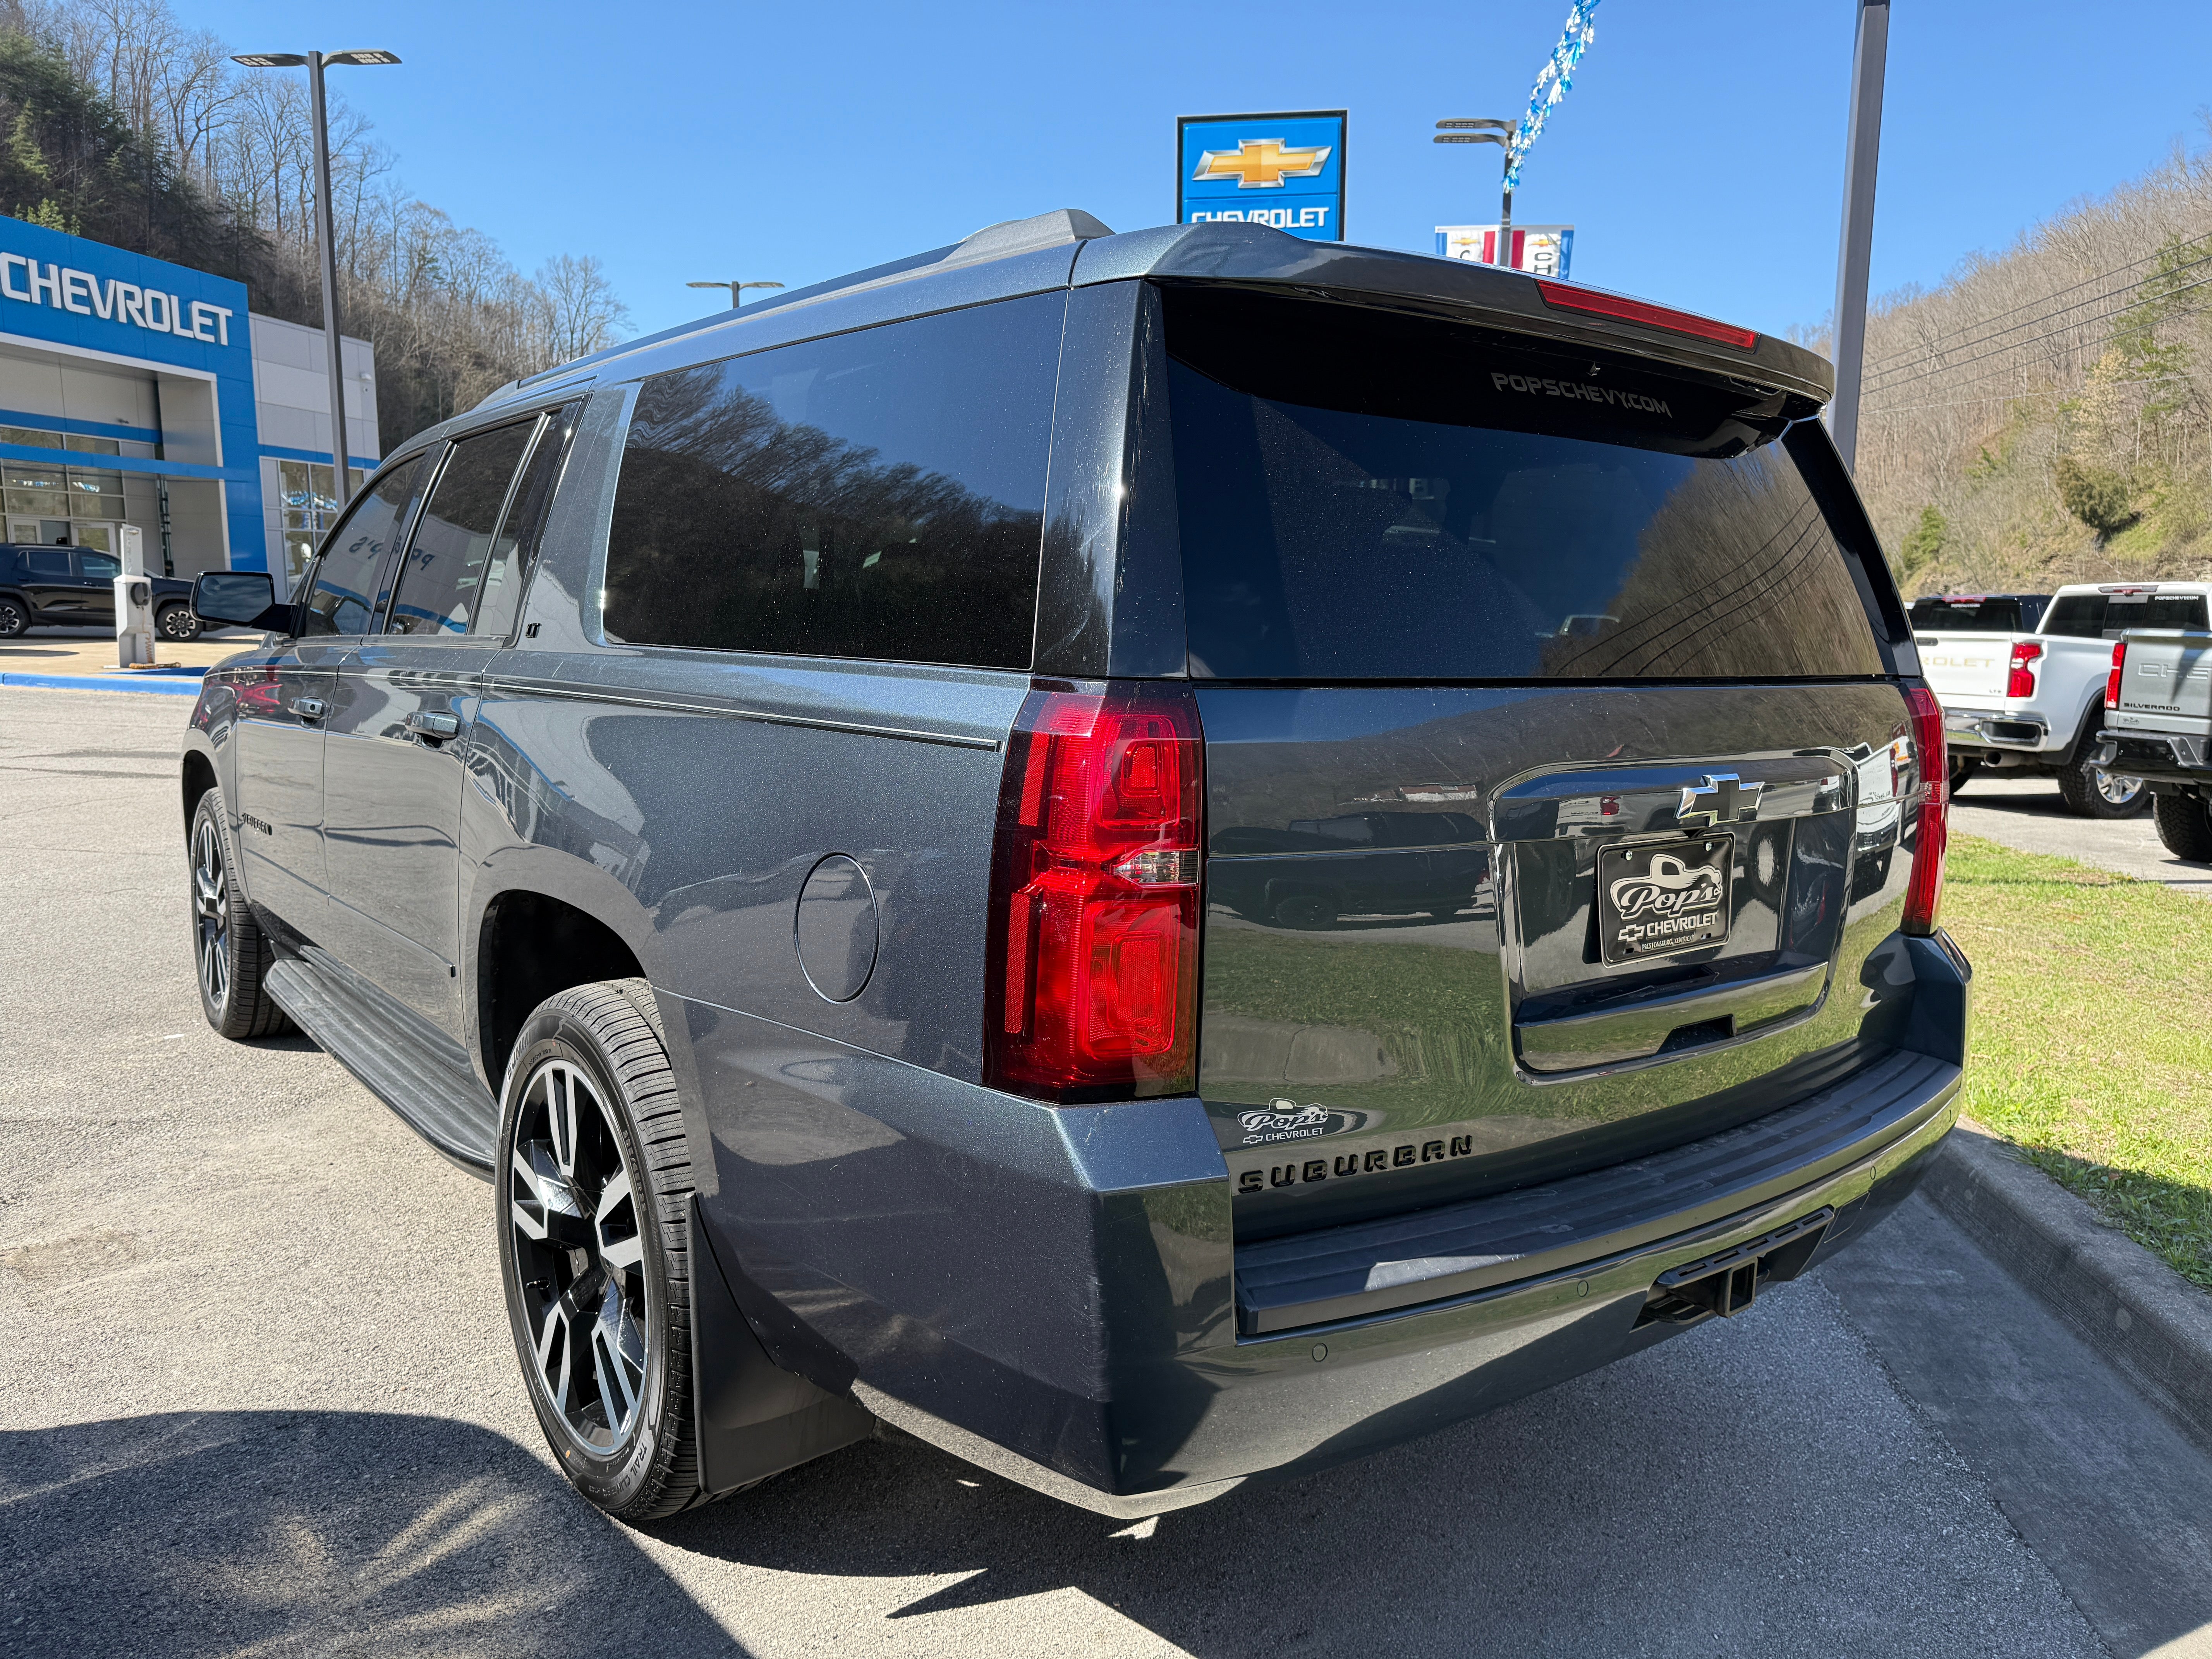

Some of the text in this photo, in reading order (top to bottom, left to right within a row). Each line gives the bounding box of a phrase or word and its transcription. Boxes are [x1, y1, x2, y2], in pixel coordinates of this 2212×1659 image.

[0, 252, 232, 346] CHEVROLET
[1491, 372, 1673, 418] POPSCHEVY.COM
[2124, 702, 2180, 711] SILVERADO
[1620, 883, 1716, 914] Pop's
[1647, 912, 1717, 937] CHEVROLET
[1674, 934, 1695, 945] KENTUCKY
[507, 1025, 539, 1081] SUMMIT
[1266, 1127, 1324, 1142] CHEVROLET
[1238, 1135, 1472, 1194] SUBURBAN
[630, 1442, 647, 1476] TRAIL
